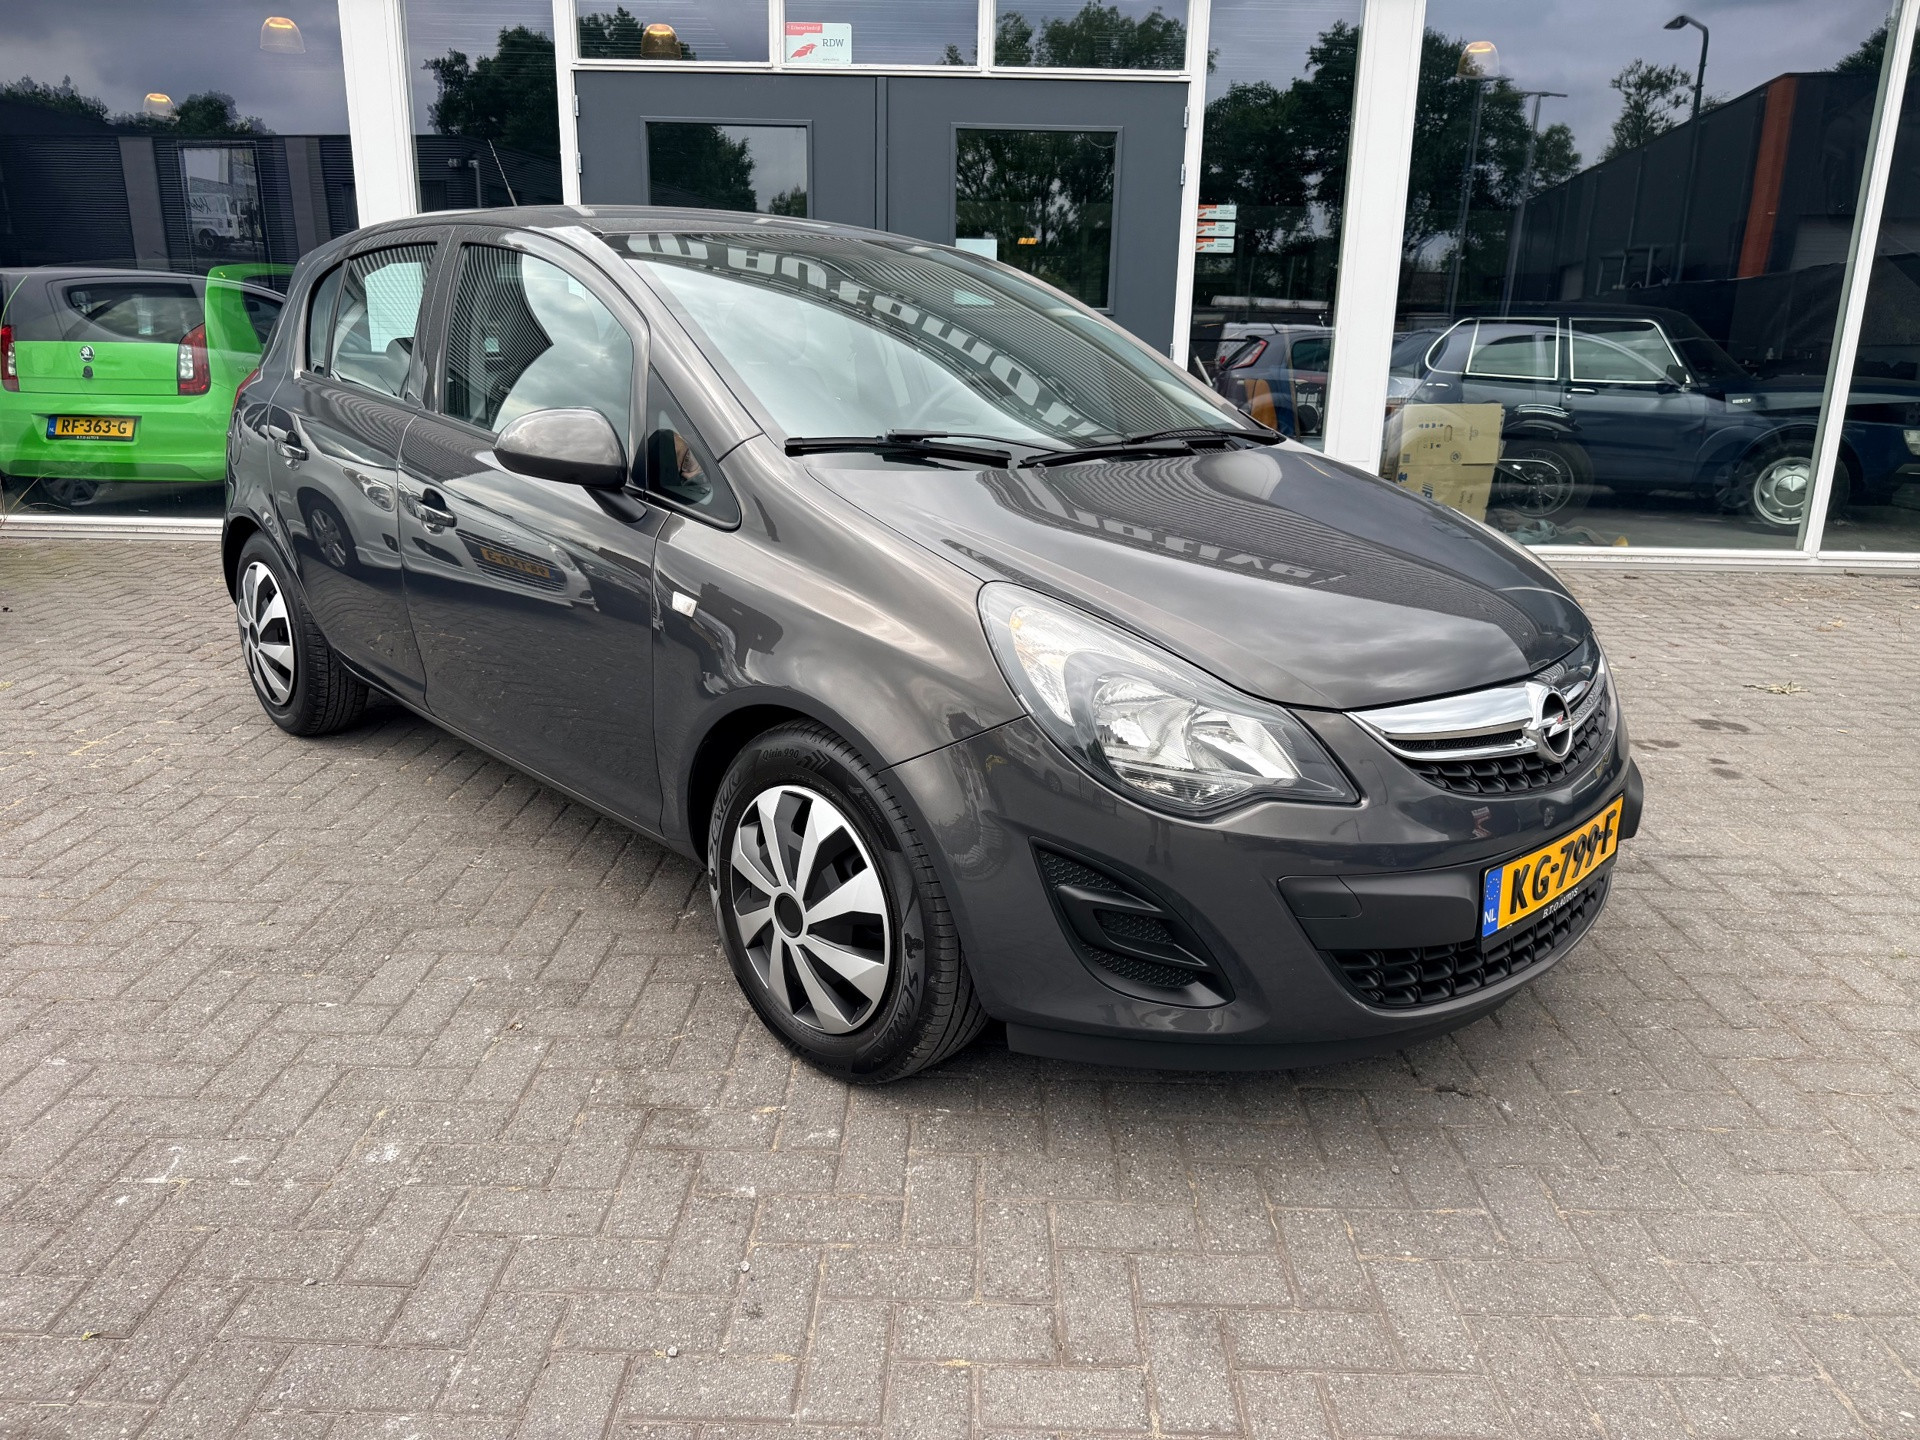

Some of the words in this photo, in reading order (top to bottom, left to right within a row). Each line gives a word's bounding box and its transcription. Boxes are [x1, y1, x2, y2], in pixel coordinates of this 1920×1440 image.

[822, 38, 845, 47] RDW
[60, 418, 127, 434] RF-363-G
[783, 747, 799, 760] 990
[1483, 908, 1497, 925] NL
[1509, 808, 1618, 915] KG-799-F
